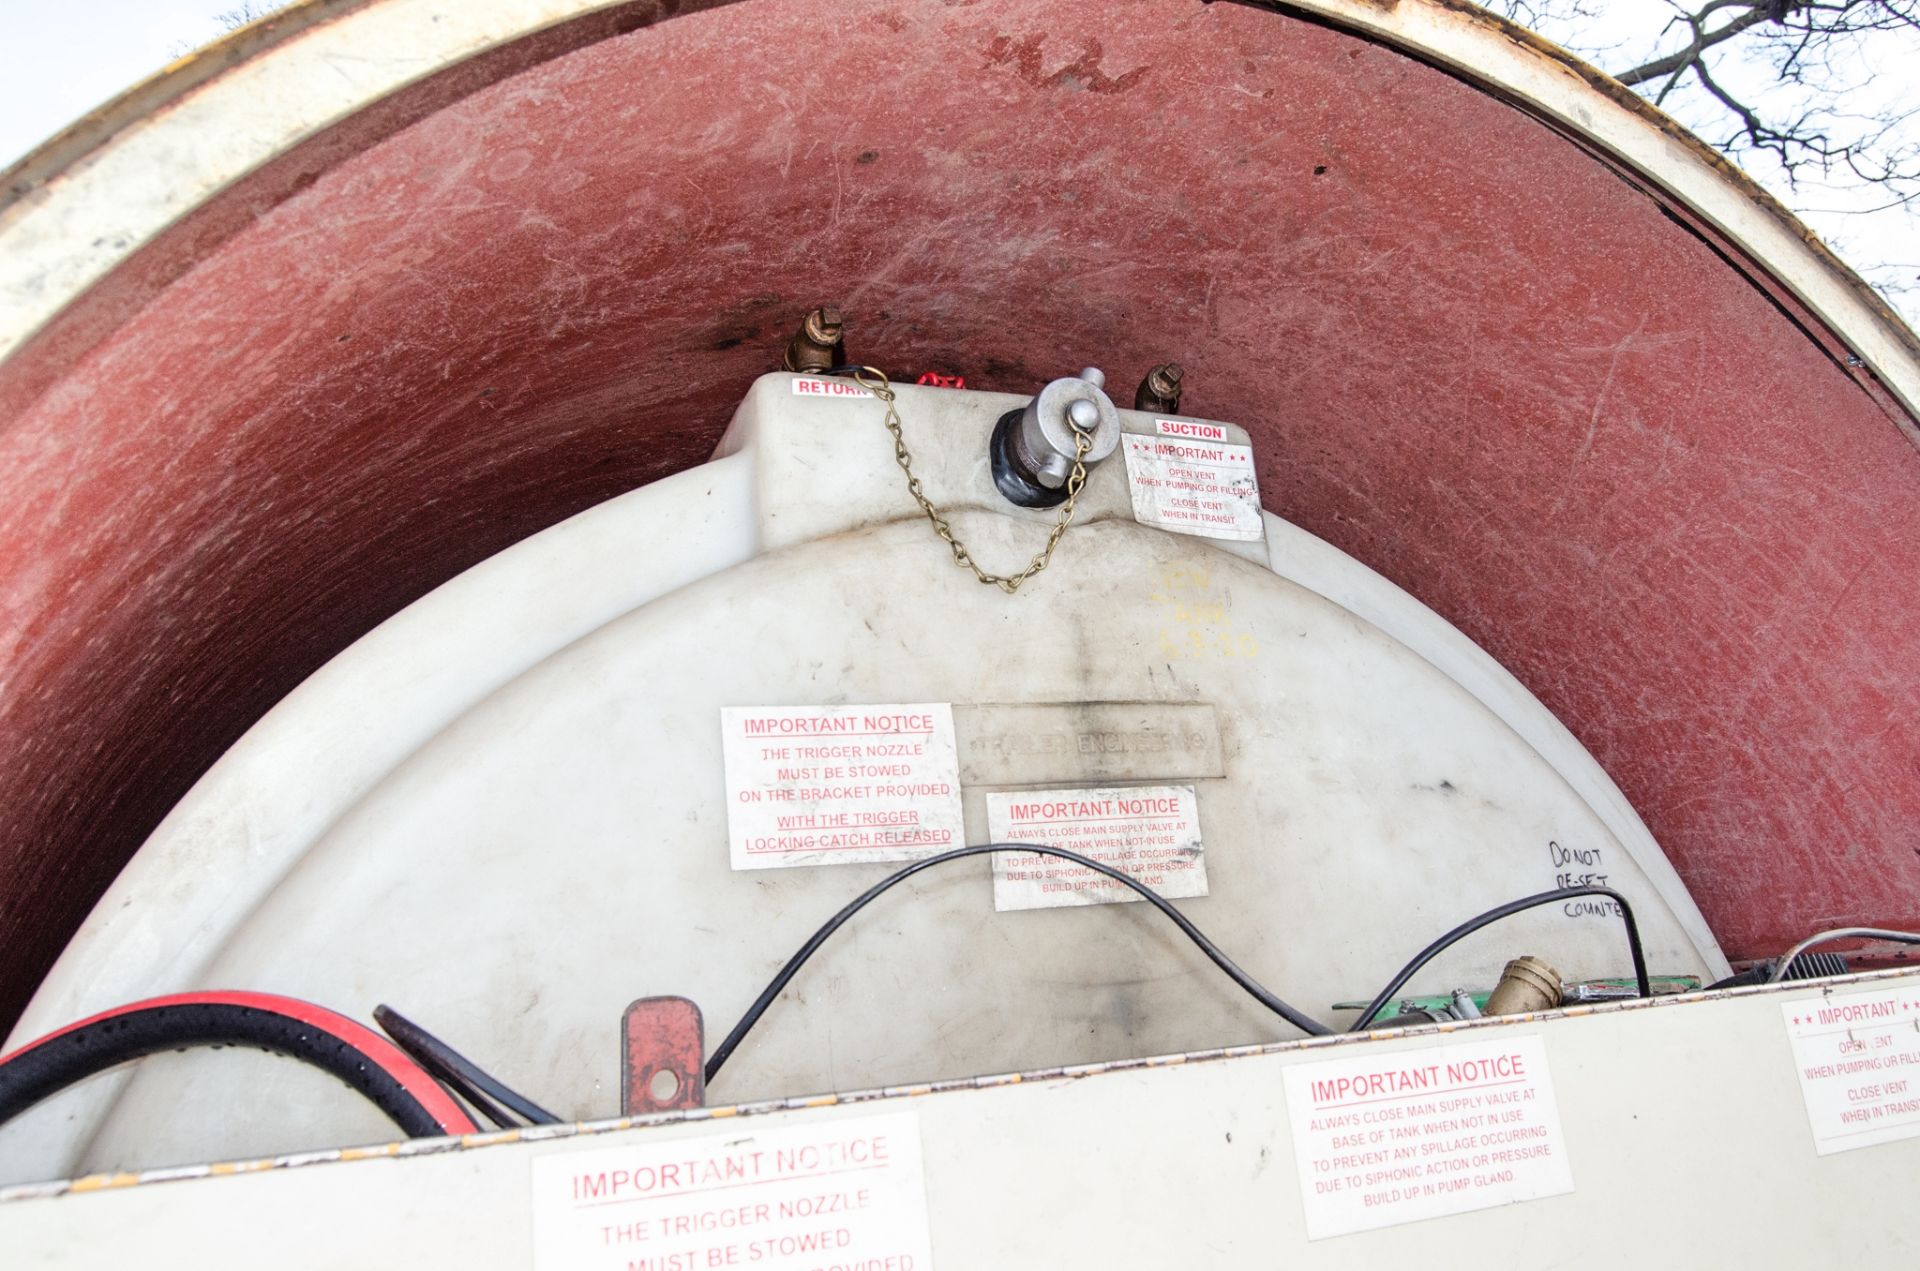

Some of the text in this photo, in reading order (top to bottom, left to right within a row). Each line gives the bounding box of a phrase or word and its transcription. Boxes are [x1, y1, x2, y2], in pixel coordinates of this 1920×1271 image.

[799, 381, 868, 396] RETUR
[1162, 422, 1222, 439] SUCTION
[1155, 444, 1224, 462] IMPORTANT
[1168, 468, 1216, 480] OPEN VENT
[1136, 477, 1252, 496] WHEN PUMPING OR FILLING
[1171, 498, 1222, 510] CLOSE VENT
[1162, 509, 1236, 524] WHEN IN TRANSIT
[744, 715, 934, 734] IMPORTANT NOTICE
[762, 744, 922, 760] THE TRIGGER NOZZLE
[778, 764, 911, 781] MUST BE STOWED
[739, 784, 950, 802] ON THE BRACKET PROVIDED
[1010, 798, 1180, 820] IMPORTANT NOTICE
[777, 810, 919, 828] WITH THE TRIGGER
[745, 830, 952, 851] LOCKING CATCH RELEASED
[1007, 822, 1186, 840] ALWAYS CLOSE MAIN SUPPLY VALVE AT
[1052, 842, 1064, 850] OF
[1068, 840, 1092, 849] TANK
[1095, 838, 1124, 848] WHEN
[1146, 836, 1155, 844] IN
[1158, 836, 1176, 844] USE
[1008, 858, 1020, 868] TO
[1092, 852, 1137, 863] SPILLAGE
[1139, 848, 1192, 859] OCCURRING
[1550, 841, 1602, 868] DO NOT
[1007, 872, 1026, 882] DUE
[1030, 870, 1043, 880] TO
[1046, 868, 1091, 879] SIPHONIC
[1132, 863, 1145, 873] OR
[1148, 861, 1195, 872] PRESSURE
[1556, 873, 1608, 888] RE-SET
[1042, 883, 1072, 894] BUILD
[1074, 882, 1088, 892] UP
[1090, 881, 1100, 890] IN
[1102, 879, 1124, 891] PUM
[1564, 900, 1624, 918] COUNTE
[1818, 1000, 1897, 1025] IMPORTANT
[1838, 1035, 1894, 1054] OPEN ENT
[1311, 1054, 1526, 1102] IMPORTANT NOTICE
[1804, 1064, 1836, 1080] WHEN
[1837, 1058, 1882, 1076] PUMPING
[1848, 1080, 1908, 1101] CLOSE VENT
[1310, 1088, 1536, 1132] ALWAYS CLOSE MAIN SUPPLY VALVE AT
[1840, 1098, 1920, 1124] WHEN IN TRANSI
[1332, 1110, 1524, 1150] BASE OF TANK WHEN NOT IN USE
[1313, 1125, 1548, 1174] TO PREVENT ANY SPILLAGE OCCURRING
[572, 1136, 889, 1200] IMPORTANT NOTICE
[1316, 1144, 1552, 1194] DUE TO SIPHONIC ACTION OR PRESSURE
[1364, 1170, 1517, 1208] BUILD UP IN PUMP GLAND.
[602, 1190, 870, 1246] THE TRIGGER NOZZLE
[628, 1228, 850, 1271] MUST BE STOWED
